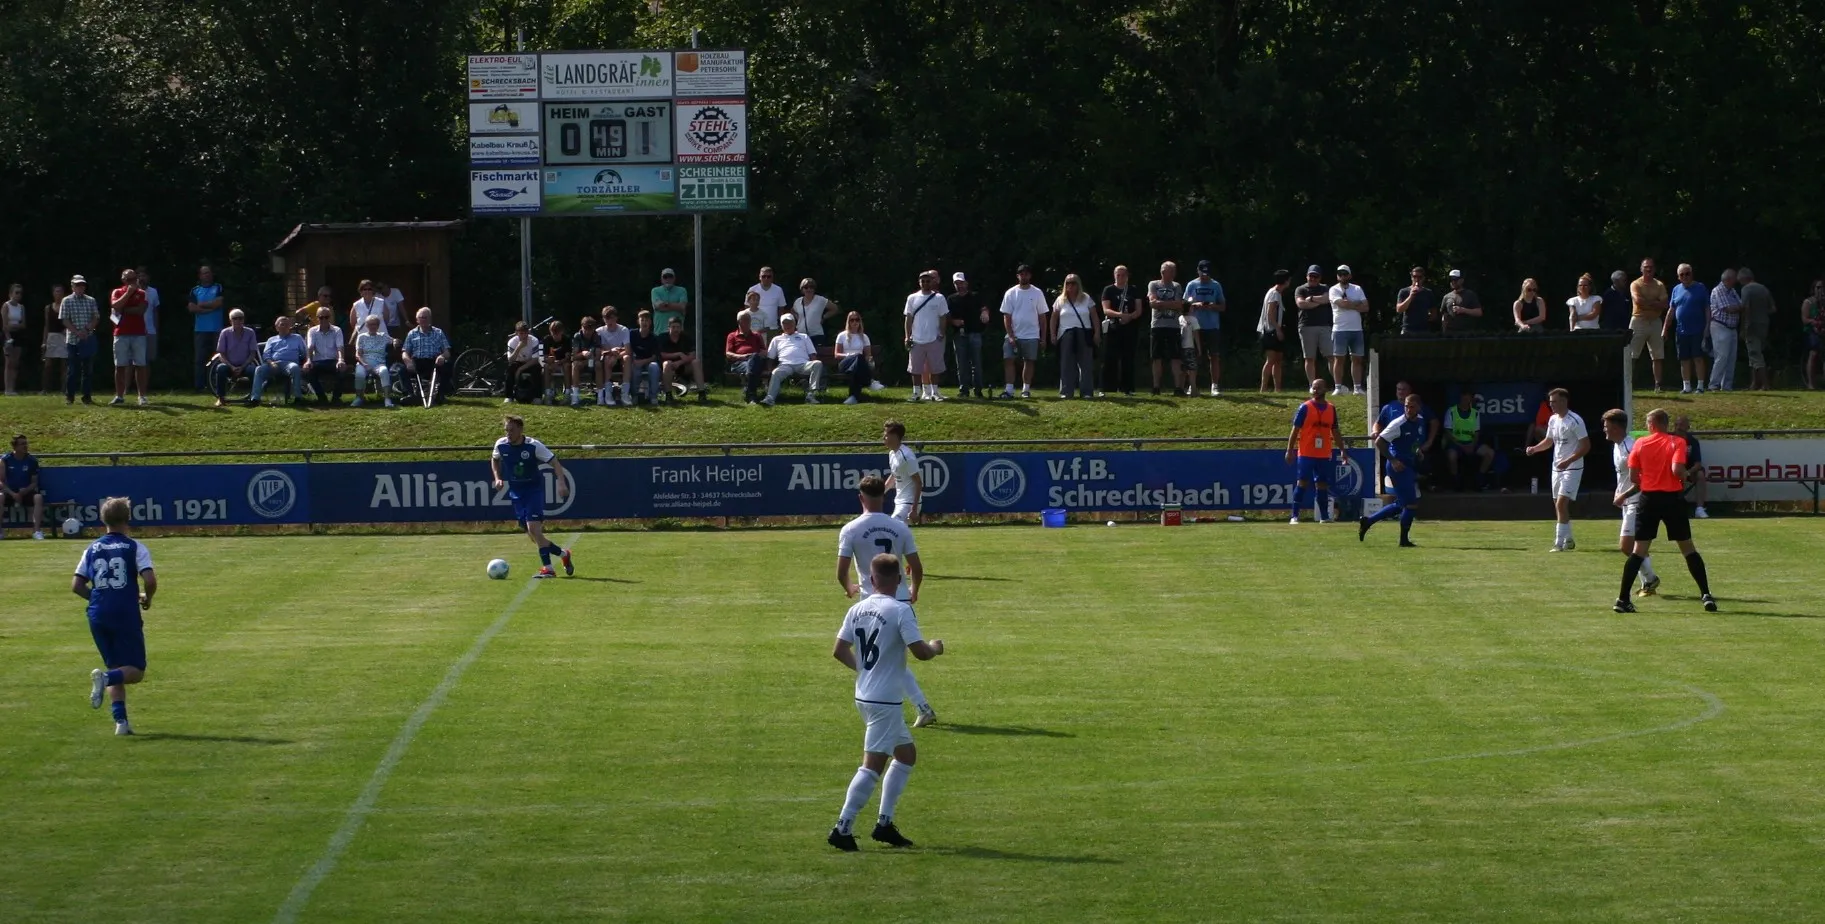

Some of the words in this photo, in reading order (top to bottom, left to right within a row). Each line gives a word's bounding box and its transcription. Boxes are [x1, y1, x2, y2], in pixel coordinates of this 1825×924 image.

[469, 56, 523, 64] ELEKTRO-EUL
[543, 65, 554, 84] die
[555, 60, 638, 85] LANDGRÄF
[635, 76, 669, 87] innen
[550, 107, 590, 119] HEIM
[624, 106, 666, 118] GAST
[688, 119, 738, 132] STEHL's
[471, 141, 505, 149] Kabelbau
[560, 122, 581, 156] 0
[593, 125, 623, 147] 49
[703, 136, 736, 153] COMPANY
[596, 147, 621, 157] MIN
[679, 154, 745, 163] www.stehls.de
[472, 171, 539, 181] Fischmarkt
[679, 166, 745, 178] SCHREINEREI
[576, 184, 641, 194] TORZÄHLER
[681, 178, 743, 198] zinn
[1473, 393, 1526, 414] Gast
[651, 464, 701, 483] Frank
[706, 463, 762, 486] Heipel
[1046, 457, 1116, 481] V.f.B.
[369, 472, 512, 508] Allianz
[1048, 481, 1229, 508] Schrecksbach
[1240, 483, 1294, 504] 1921
[173, 498, 227, 520] 1921
[94, 557, 127, 589] 23
[854, 627, 880, 671] 16
